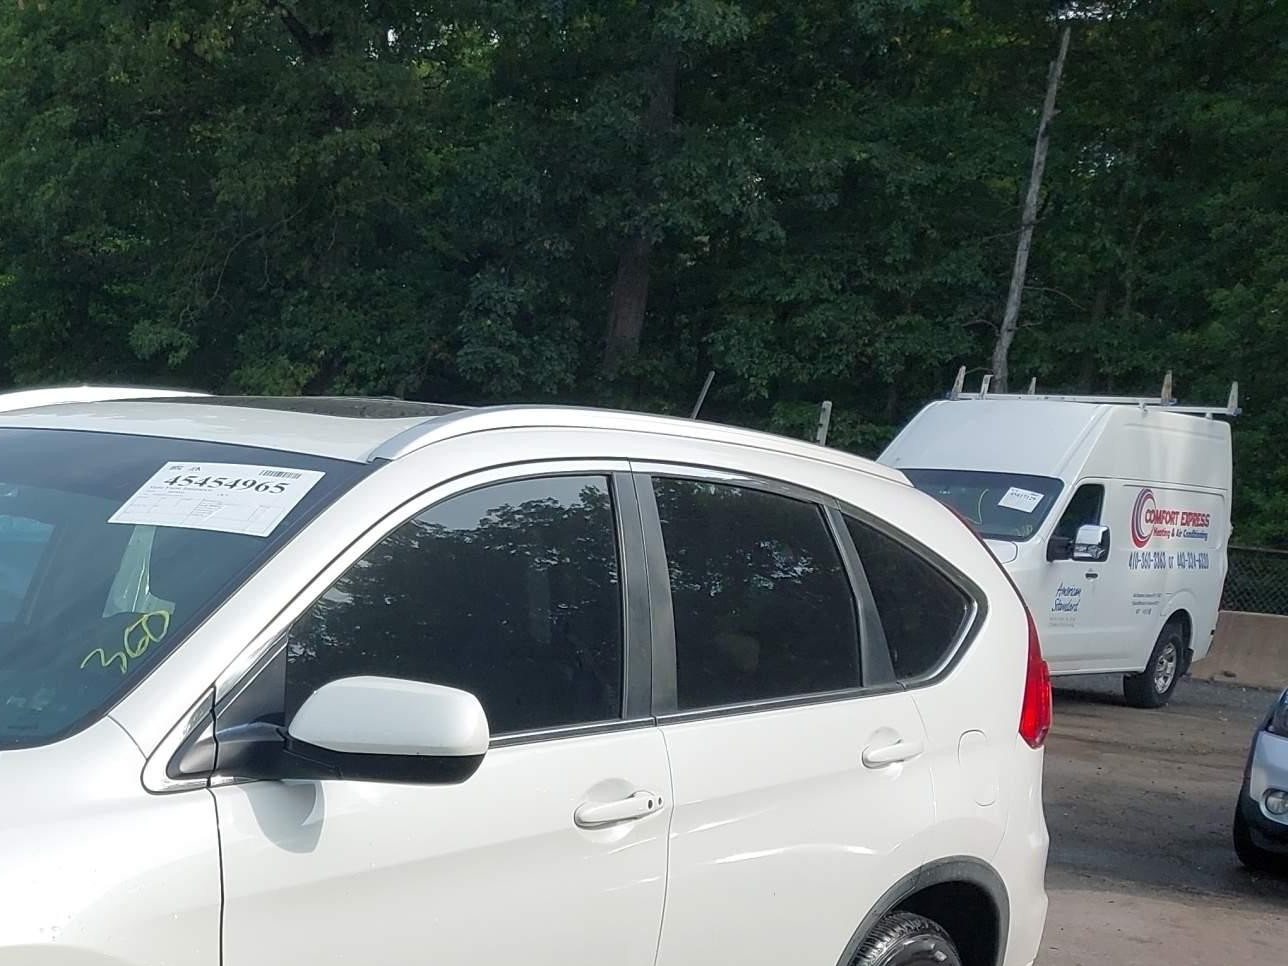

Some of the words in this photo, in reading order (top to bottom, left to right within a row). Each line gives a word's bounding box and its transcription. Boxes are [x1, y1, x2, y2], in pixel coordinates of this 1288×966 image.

[163, 475, 289, 494] 45454965
[1144, 509, 1180, 526] COMFORT
[1180, 511, 1211, 528] EXPRESS
[79, 609, 171, 675] 360
